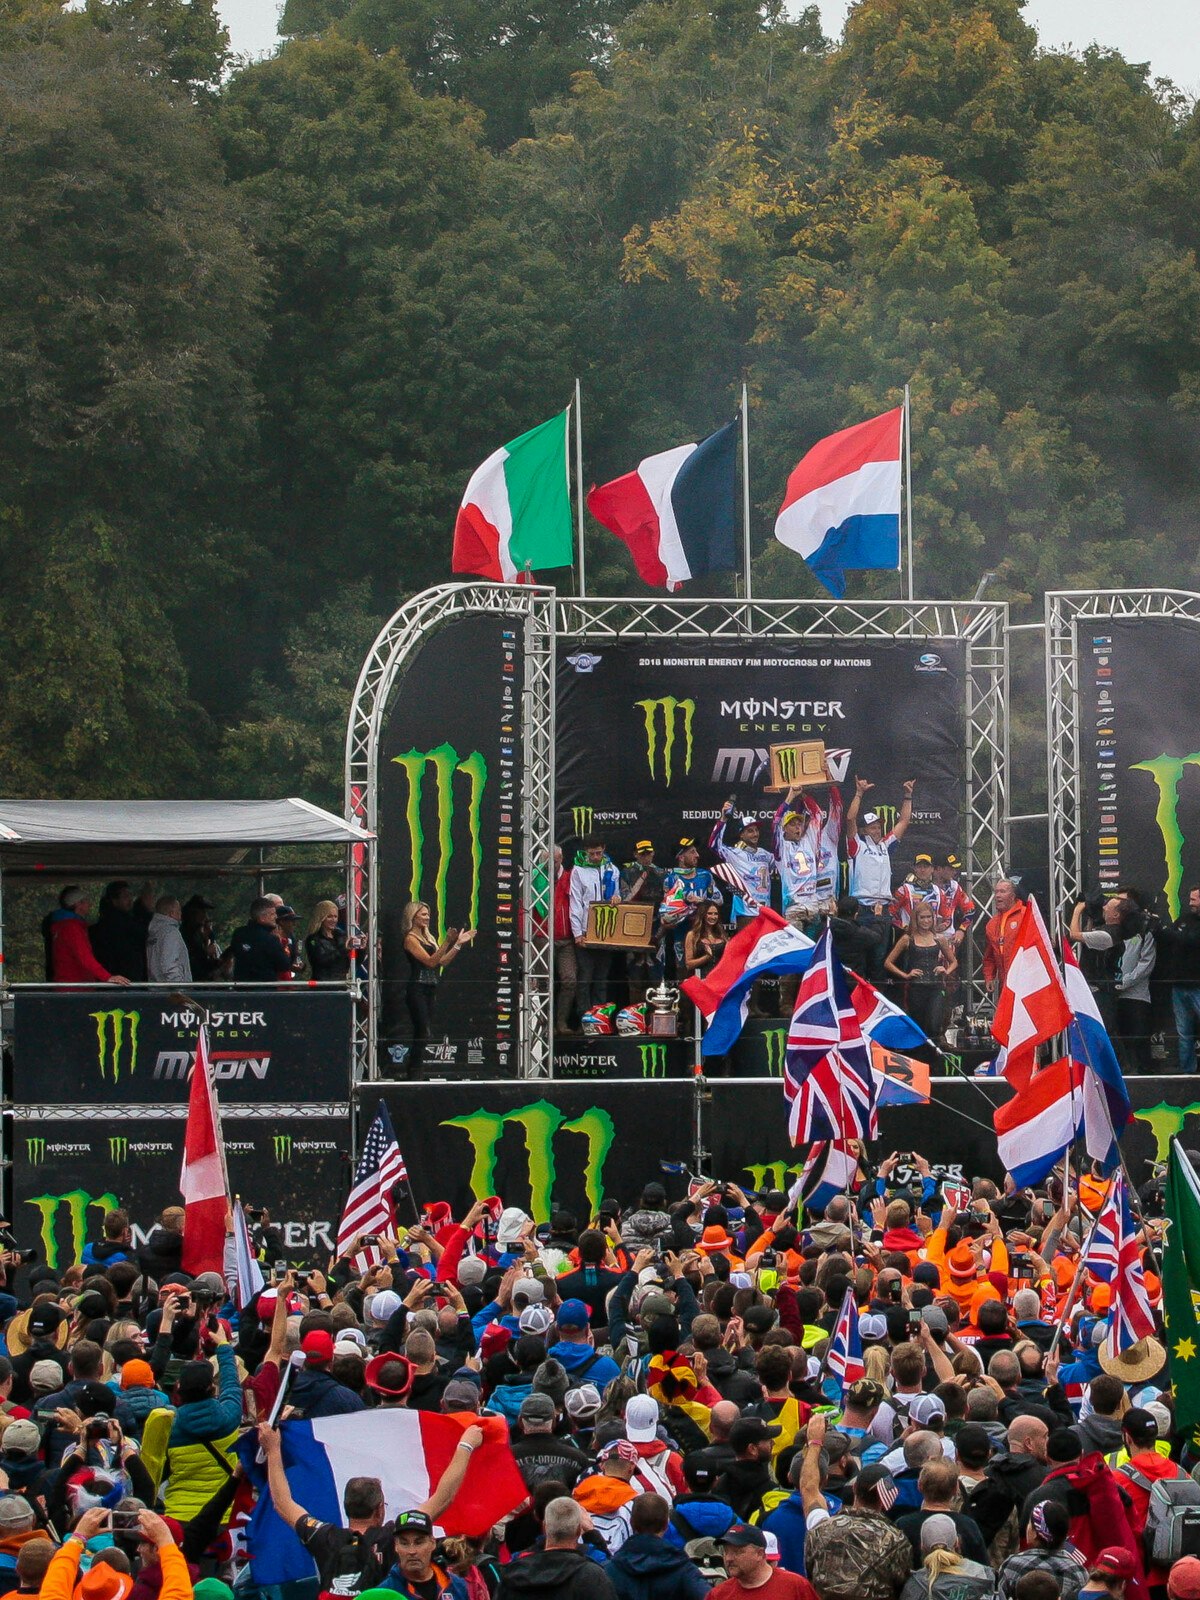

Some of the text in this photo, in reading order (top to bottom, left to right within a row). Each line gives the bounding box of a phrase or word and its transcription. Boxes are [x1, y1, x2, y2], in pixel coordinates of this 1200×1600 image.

[639, 658, 872, 667] 2018 MONSTER ENERGY FIM MOTOCROSS OF NATIONS
[721, 697, 846, 720] MONSTER
[740, 723, 829, 732] ENERGY
[594, 811, 638, 820] MONSTER
[682, 811, 722, 819] REDBUD
[177, 1030, 251, 1038] ENRGY
[553, 1054, 618, 1067] MONSTER
[46, 1143, 91, 1151] MONSTER
[129, 1142, 174, 1151] MONSTER
[293, 1141, 337, 1150] MONSTER
